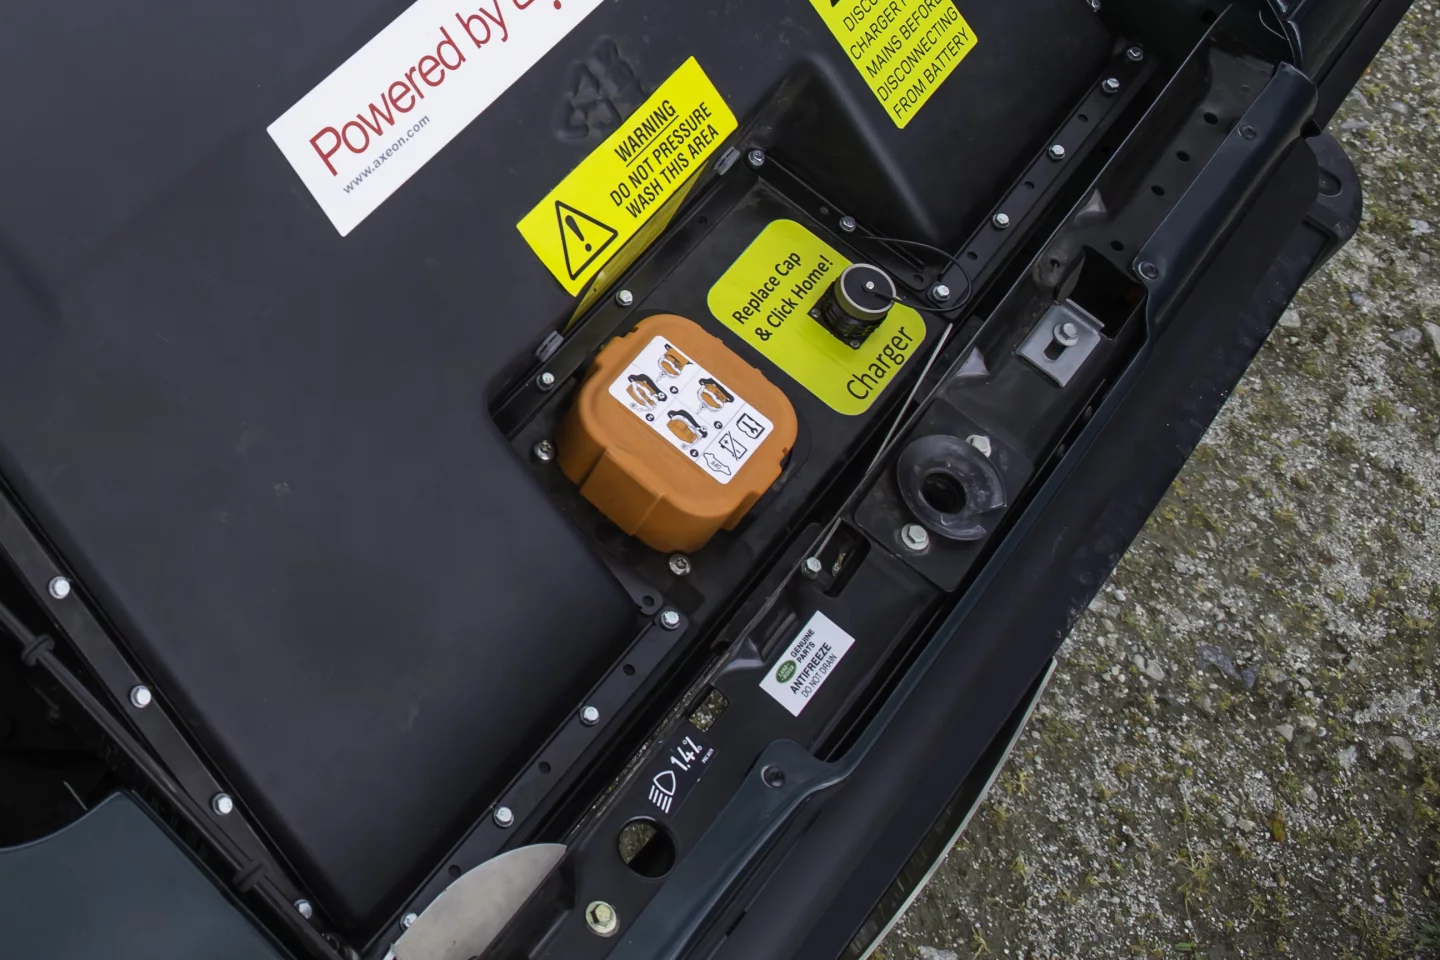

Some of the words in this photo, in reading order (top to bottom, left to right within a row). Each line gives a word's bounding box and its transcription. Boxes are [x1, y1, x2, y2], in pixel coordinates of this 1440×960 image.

[849, 1, 901, 60] CHARGER
[866, 35, 903, 78] MAINS
[877, 6, 958, 102] DISCONNECTING
[309, 26, 467, 177] Powered
[893, 78, 927, 120] FROM
[924, 27, 969, 84] BATTERY
[342, 115, 431, 195] www.axeon.com
[610, 182, 631, 207] DO
[628, 157, 655, 188] NOT
[652, 101, 712, 165] PRESSURE
[614, 99, 677, 163] WARNING
[626, 178, 664, 219] WASH
[659, 152, 689, 184] THIS
[687, 124, 719, 160] AREA
[731, 273, 780, 325] Replace
[775, 250, 802, 279] Cap
[755, 327, 773, 342] &
[767, 295, 800, 329] Click
[794, 254, 834, 296] Home!
[846, 326, 915, 401] Charger
[711, 460, 722, 470] OFF
[778, 665, 788, 677] LAND
[783, 665, 794, 680] ROVER
[790, 642, 832, 694] ANTIFREEZE
[791, 628, 815, 657] GENUINE
[797, 641, 815, 663] PARTS
[801, 686, 812, 697] DO
[809, 672, 822, 688] NOT
[819, 653, 837, 674] DRAIN
